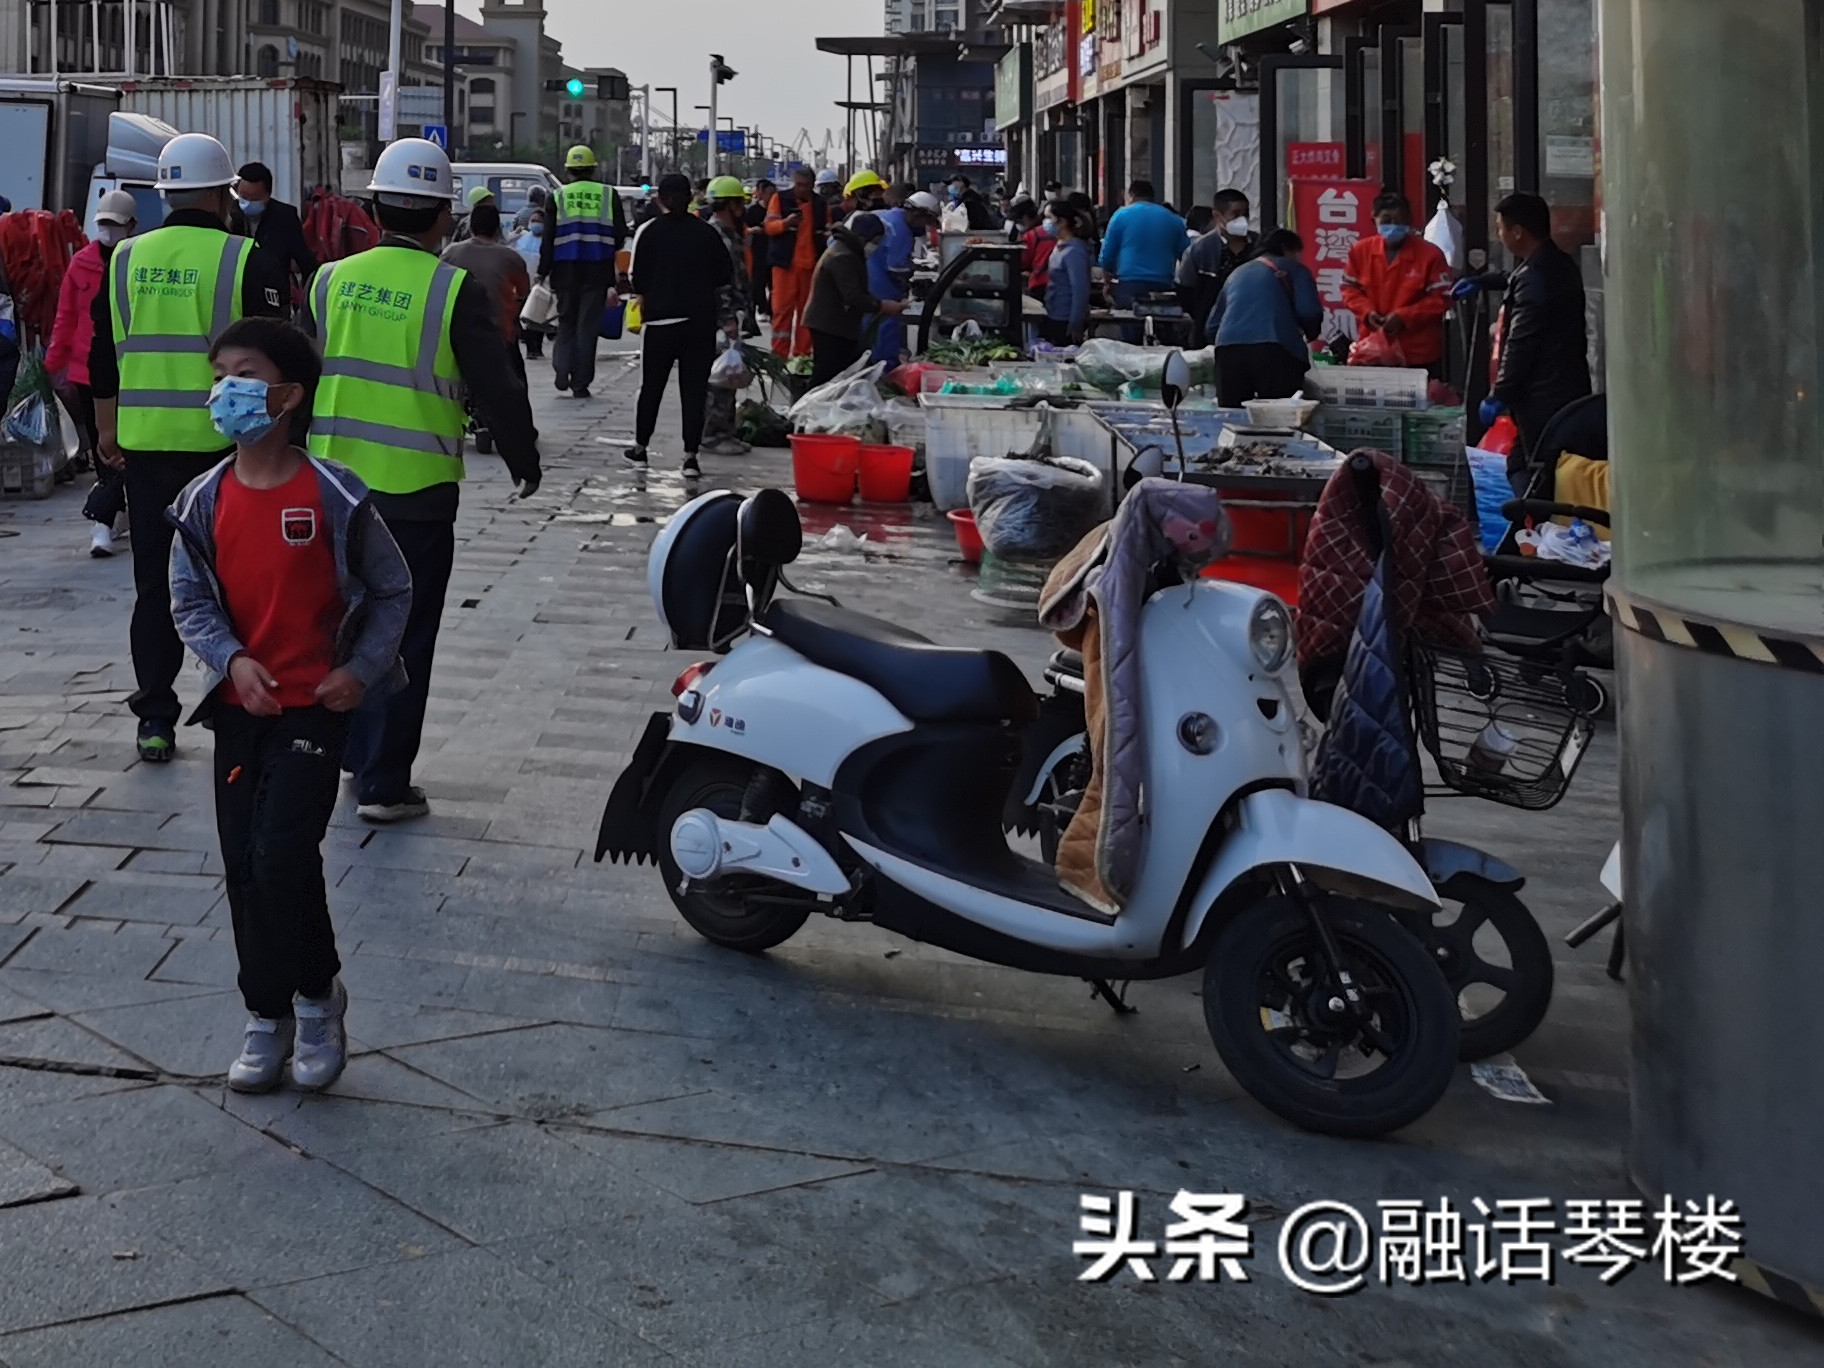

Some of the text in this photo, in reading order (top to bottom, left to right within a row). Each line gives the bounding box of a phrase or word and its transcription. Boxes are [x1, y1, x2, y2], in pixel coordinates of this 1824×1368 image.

[134, 267, 199, 285] 建艺集团
[1314, 187, 1360, 348] 台湾手抓
[338, 281, 413, 310] 建艺集团
